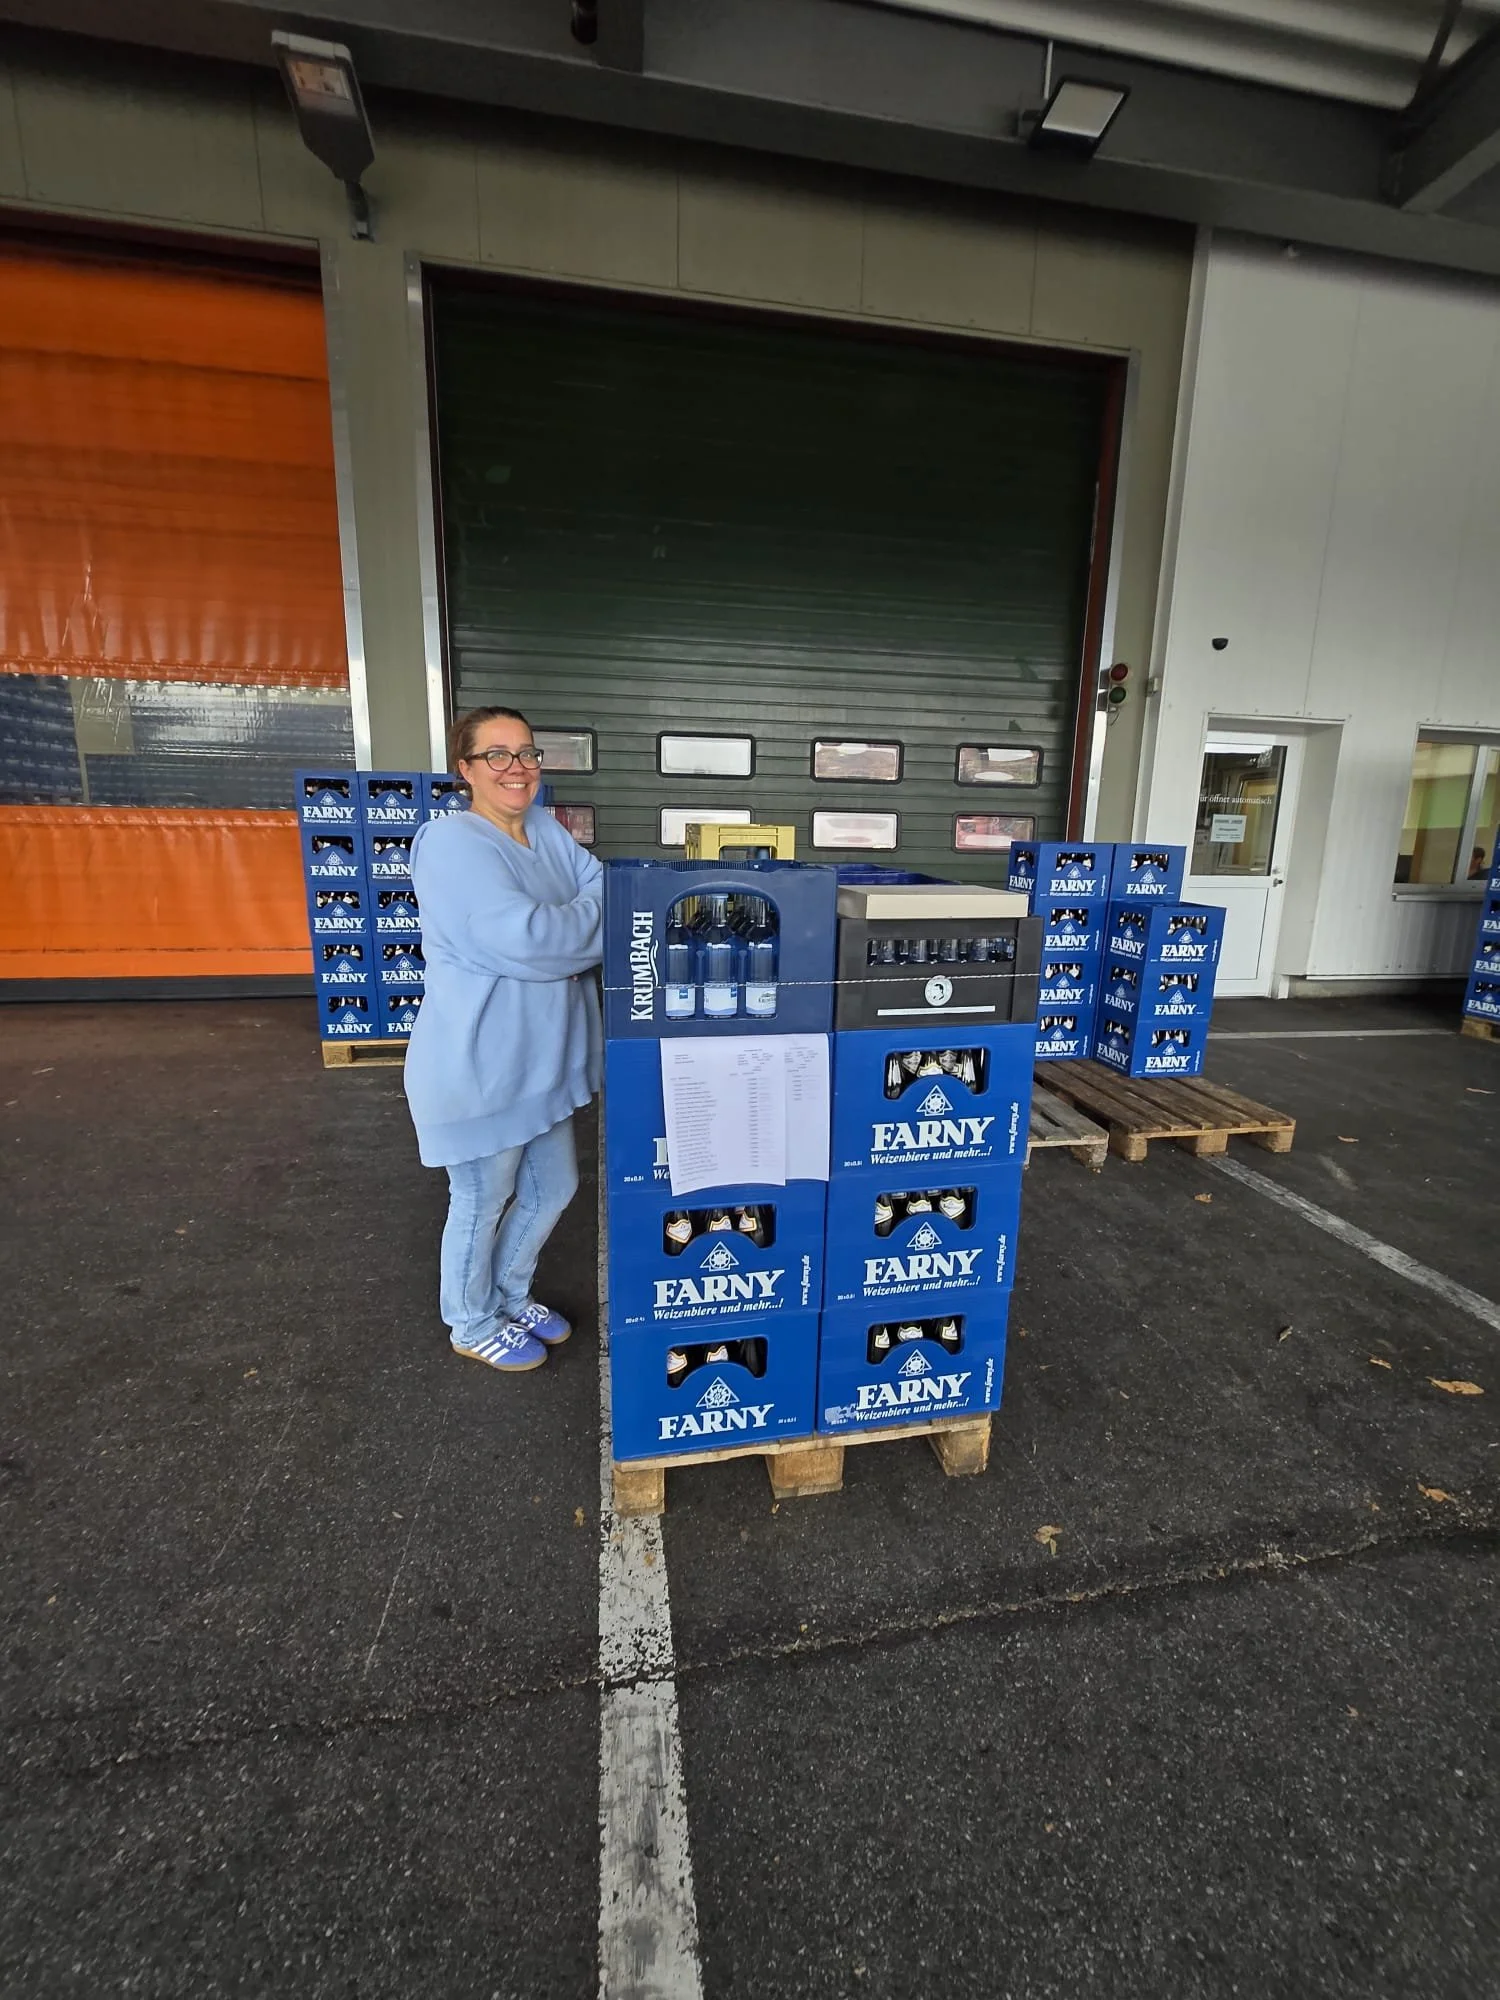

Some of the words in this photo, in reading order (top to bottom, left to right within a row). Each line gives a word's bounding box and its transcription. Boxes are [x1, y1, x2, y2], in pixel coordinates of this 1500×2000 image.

[1200, 794, 1208, 802] ür
[1232, 796, 1272, 804] automatisch
[302, 806, 355, 820] FARNY
[366, 808, 418, 820] FARNY
[310, 866, 358, 876] FARNY
[372, 864, 410, 874] FARN
[1009, 876, 1035, 890] FARNY
[1050, 880, 1096, 891] FARNY
[1126, 884, 1167, 894] FARNY
[314, 918, 365, 929] FARNY
[1045, 935, 1090, 946] FARNY
[1110, 936, 1145, 955] FARNY
[1161, 945, 1208, 957] FARNY
[630, 911, 653, 1021] KRUMBACH
[1475, 960, 1500, 971] FAR
[321, 973, 368, 983] FARNY
[381, 970, 425, 981] FARNY
[1040, 989, 1085, 1000] FARNY
[1105, 994, 1135, 1013] FARNY
[1154, 1004, 1197, 1015] FARNY
[327, 1024, 372, 1034] FARNY
[387, 1023, 413, 1032] FAR
[1035, 1040, 1079, 1052] FARNY
[1097, 1043, 1129, 1066] FARNY
[1145, 1056, 1191, 1068] FARNY
[870, 1116, 995, 1152] FARNY
[870, 1151, 930, 1164] Weizenbiere
[933, 1149, 953, 1160] und
[954, 1146, 992, 1158] mehr...!
[863, 1248, 983, 1285] FARNY
[653, 1269, 785, 1308] FARNY
[863, 1284, 920, 1297] Weizenbiere
[923, 1280, 941, 1290] und
[943, 1276, 981, 1288] mehr...!
[653, 1306, 717, 1320] Weizenbiere
[720, 1302, 740, 1314] und
[743, 1298, 784, 1312] mehr...!
[856, 1372, 972, 1410] FARNY
[855, 1404, 911, 1422] Weizenbiere
[913, 1402, 931, 1413] und
[934, 1397, 970, 1411] mehr...!
[658, 1403, 775, 1441] FARNY
